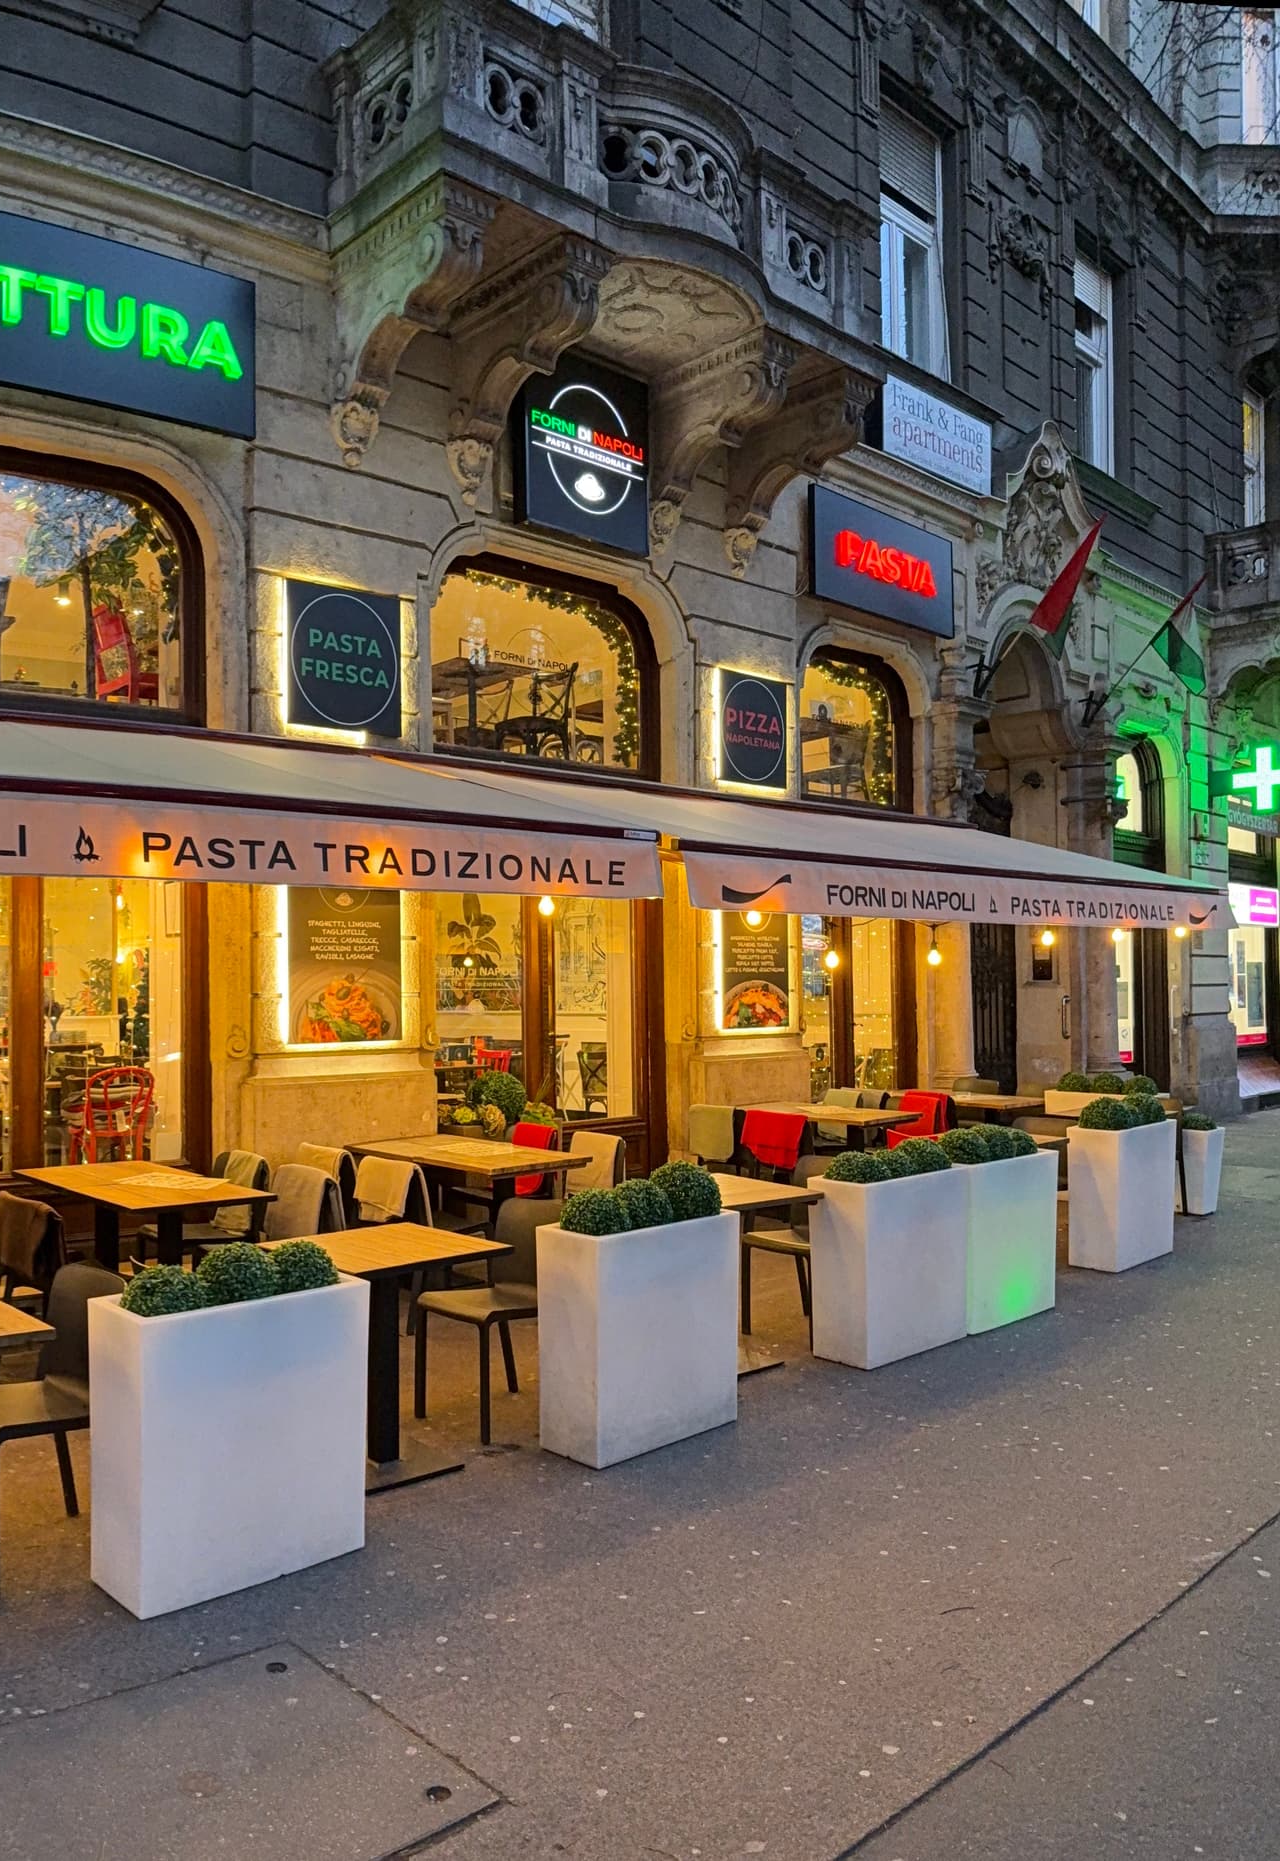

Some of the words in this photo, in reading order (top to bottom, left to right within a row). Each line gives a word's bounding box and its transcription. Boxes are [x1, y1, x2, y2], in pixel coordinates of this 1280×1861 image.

[531, 408, 575, 437] FORNI
[578, 426, 592, 442] DI
[593, 431, 643, 460] NAPOLI
[891, 383, 933, 424] Frank
[938, 407, 949, 432] &
[953, 414, 983, 454] Fang
[545, 436, 571, 451] PASTA
[573, 445, 632, 472] TRADIZIONALE
[893, 416, 983, 473] apartments
[834, 529, 938, 599] PASTA
[309, 628, 382, 658] PASTA
[494, 649, 525, 664] FORNI
[538, 659, 572, 673] NAPOL
[301, 657, 389, 689] FRESCA
[726, 707, 781, 736] PIZZA
[726, 733, 781, 750] NAPOLETANA
[142, 831, 296, 870] PASTA
[313, 841, 625, 886] TRADIZIONALE
[826, 884, 886, 908] FORNI
[892, 891, 907, 908] DI
[912, 889, 975, 912] NAPOLI
[1011, 896, 1062, 917] PASTA
[1066, 900, 1175, 921] TRADIZIONALE
